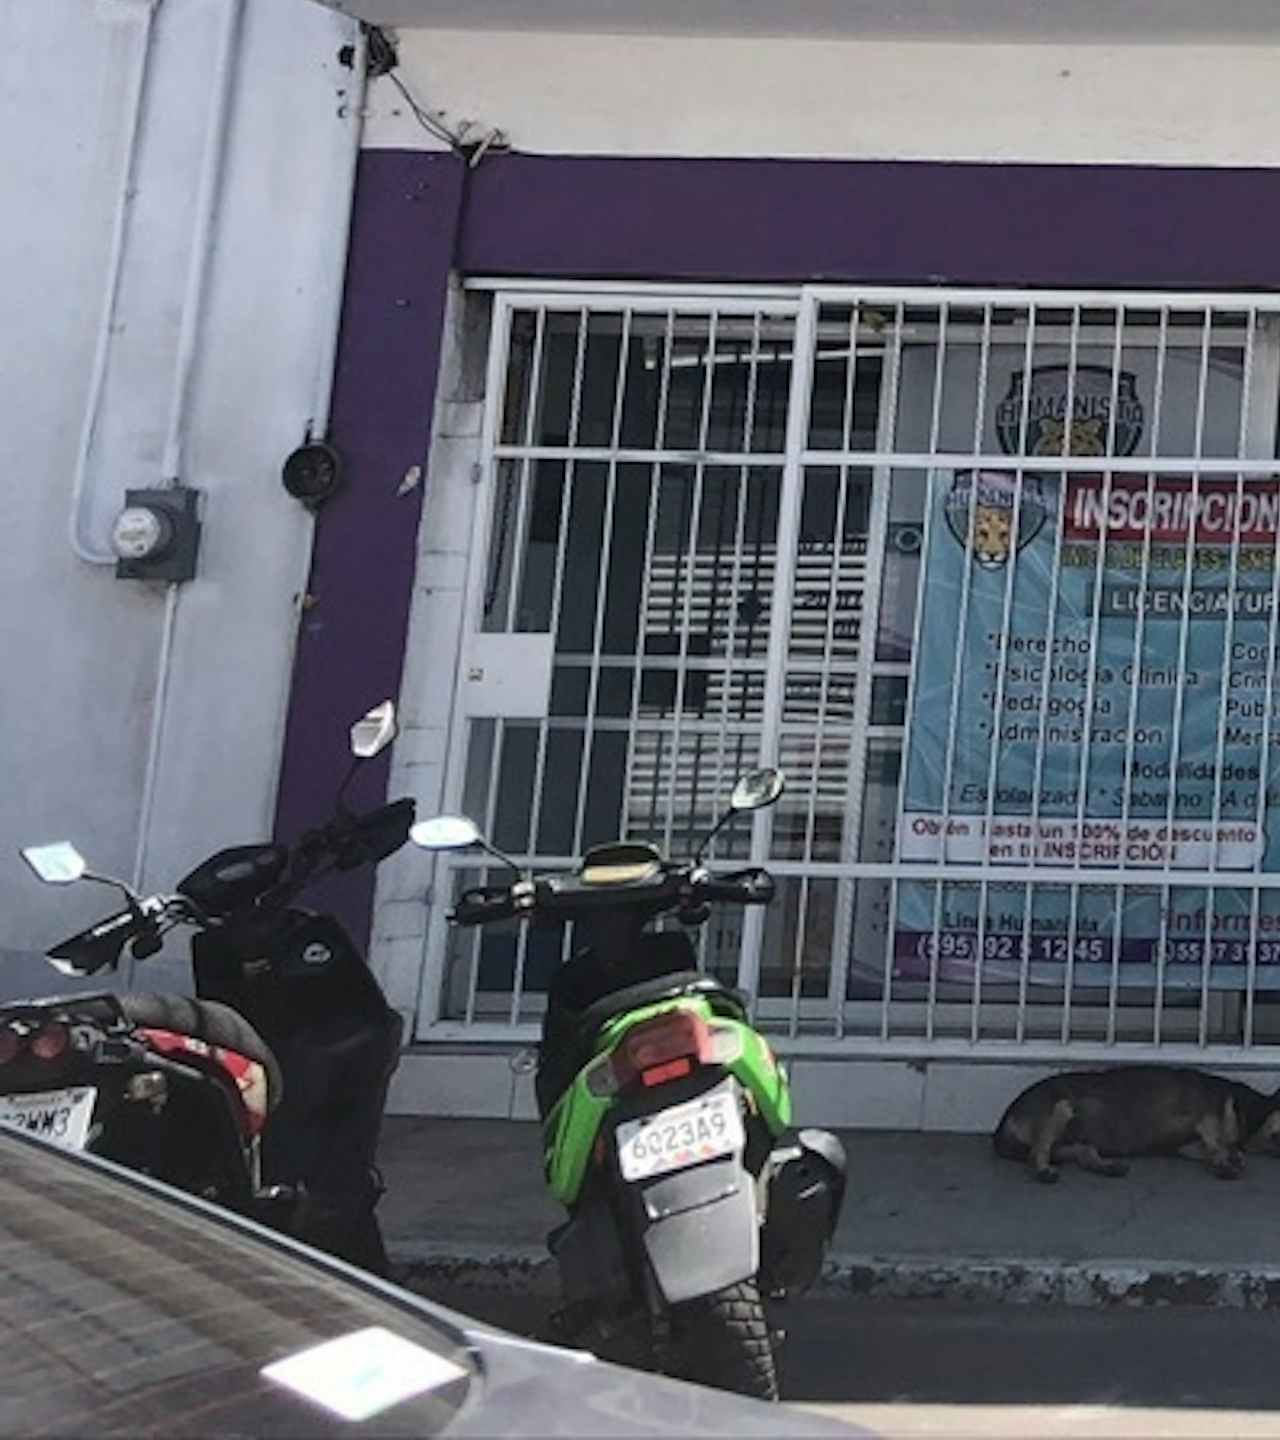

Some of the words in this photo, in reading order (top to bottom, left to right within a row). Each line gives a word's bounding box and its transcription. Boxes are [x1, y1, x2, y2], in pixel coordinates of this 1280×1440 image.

[985, 936, 1013, 958] 92
[1041, 939, 1065, 960] 12
[1073, 939, 1104, 961] 45
[1259, 945, 1280, 962] 37
